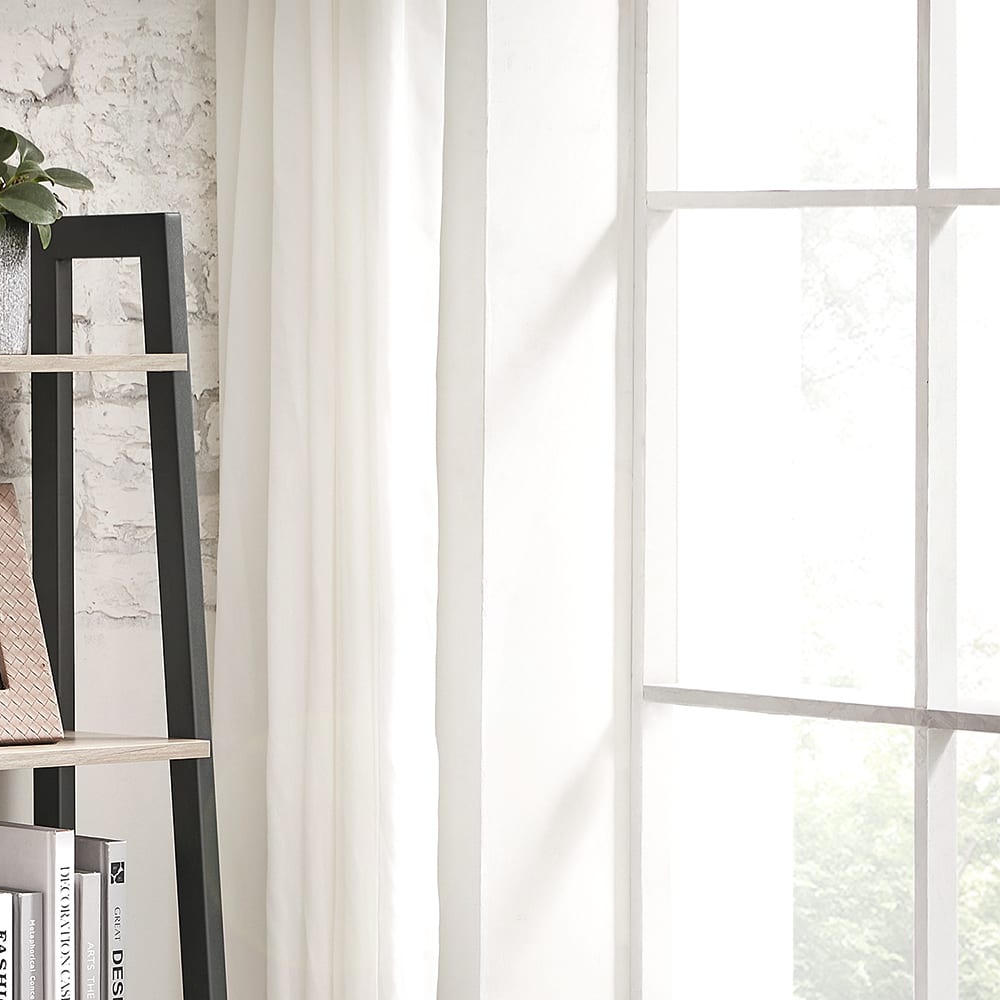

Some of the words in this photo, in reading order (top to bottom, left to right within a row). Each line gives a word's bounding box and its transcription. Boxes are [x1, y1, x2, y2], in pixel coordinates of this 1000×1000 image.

[60, 866, 70, 966] DECORATION
[113, 906, 121, 941] GREAT
[28, 919, 36, 972] Metaphorical
[86, 941, 96, 971] ARTS
[86, 976, 96, 999] THE
